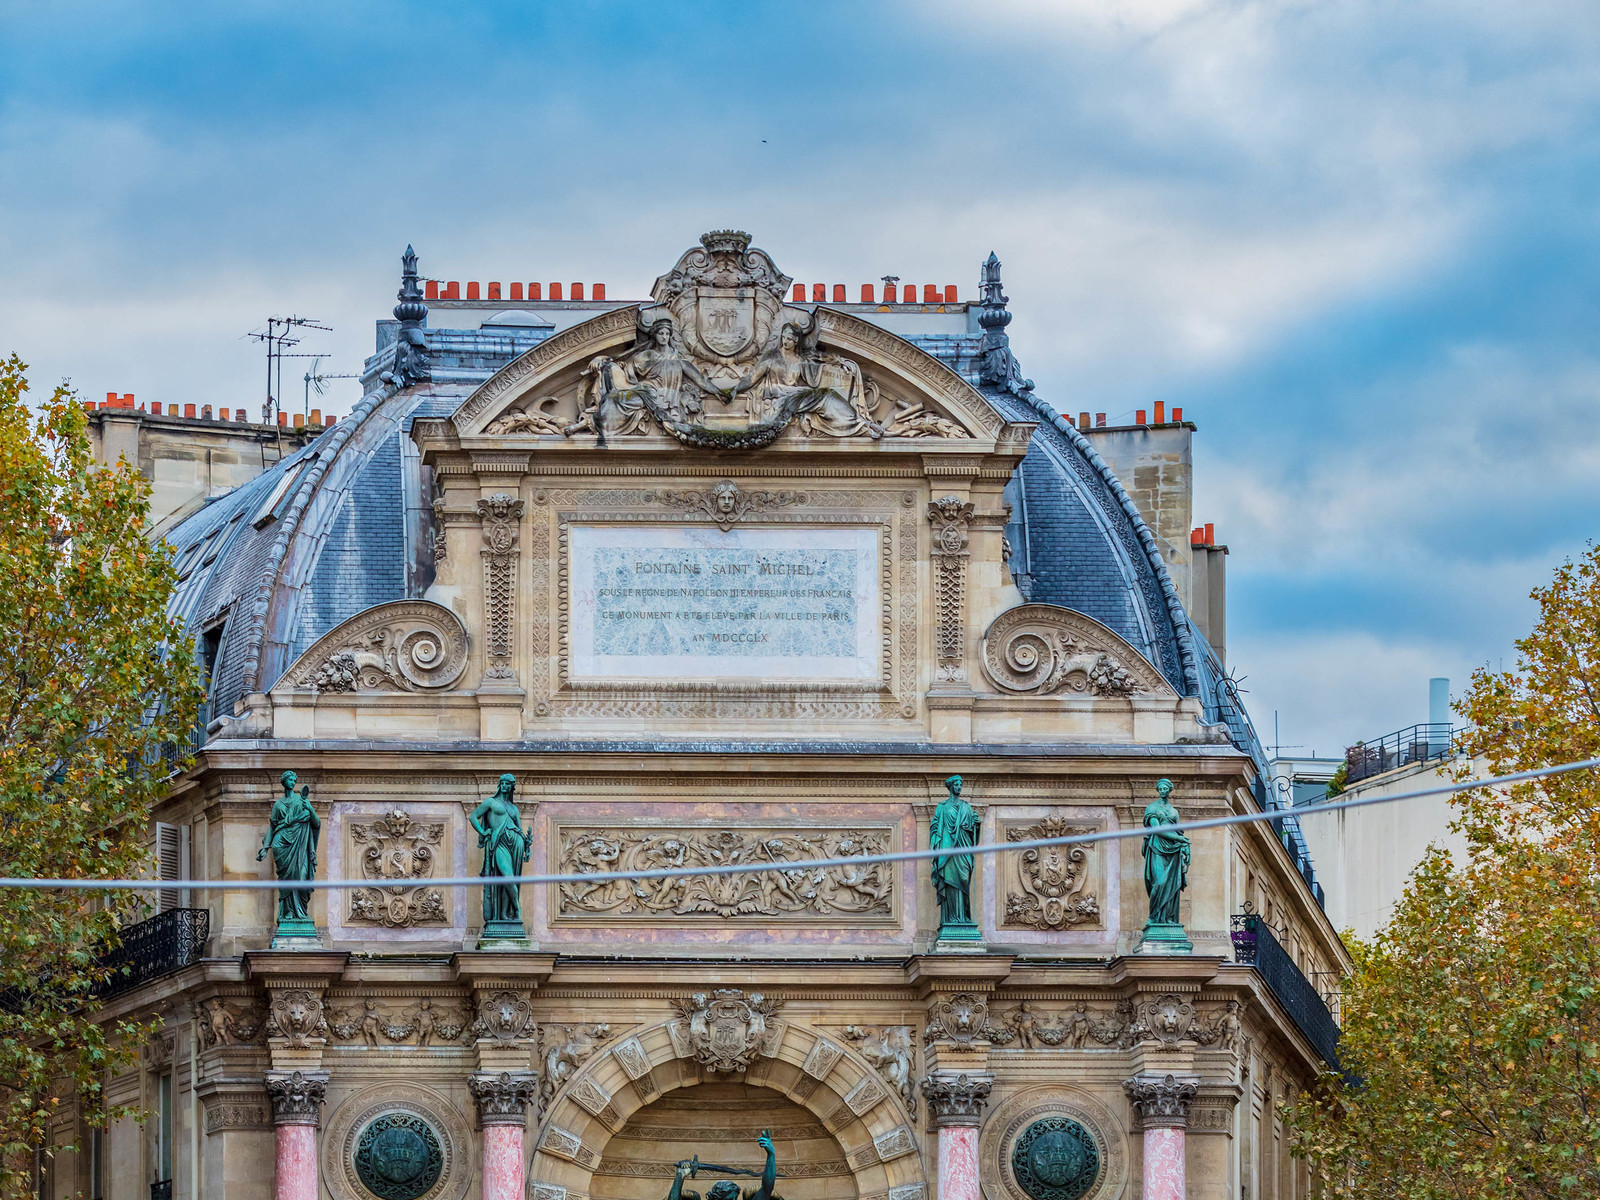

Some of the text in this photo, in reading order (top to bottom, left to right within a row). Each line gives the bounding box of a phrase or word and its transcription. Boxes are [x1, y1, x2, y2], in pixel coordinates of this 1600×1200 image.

[635, 562, 814, 576] FONTAINE SAINT MICHEL
[599, 588, 621, 597] SOUS
[622, 589, 633, 597] LE
[635, 589, 665, 597] REGNE
[667, 589, 678, 597] DE
[680, 588, 729, 597] NAPOLEON
[740, 588, 788, 598] EMPEREUR
[790, 589, 806, 598] DES
[602, 611, 614, 620] CE
[617, 611, 673, 620] MONUMENT
[675, 611, 682, 620] A
[738, 612, 757, 620] PAR
[759, 612, 771, 620] LA
[774, 612, 802, 621] VILLE
[806, 612, 818, 621] DE
[821, 612, 850, 621] PARIS
[711, 633, 768, 643] MDCCCLX
